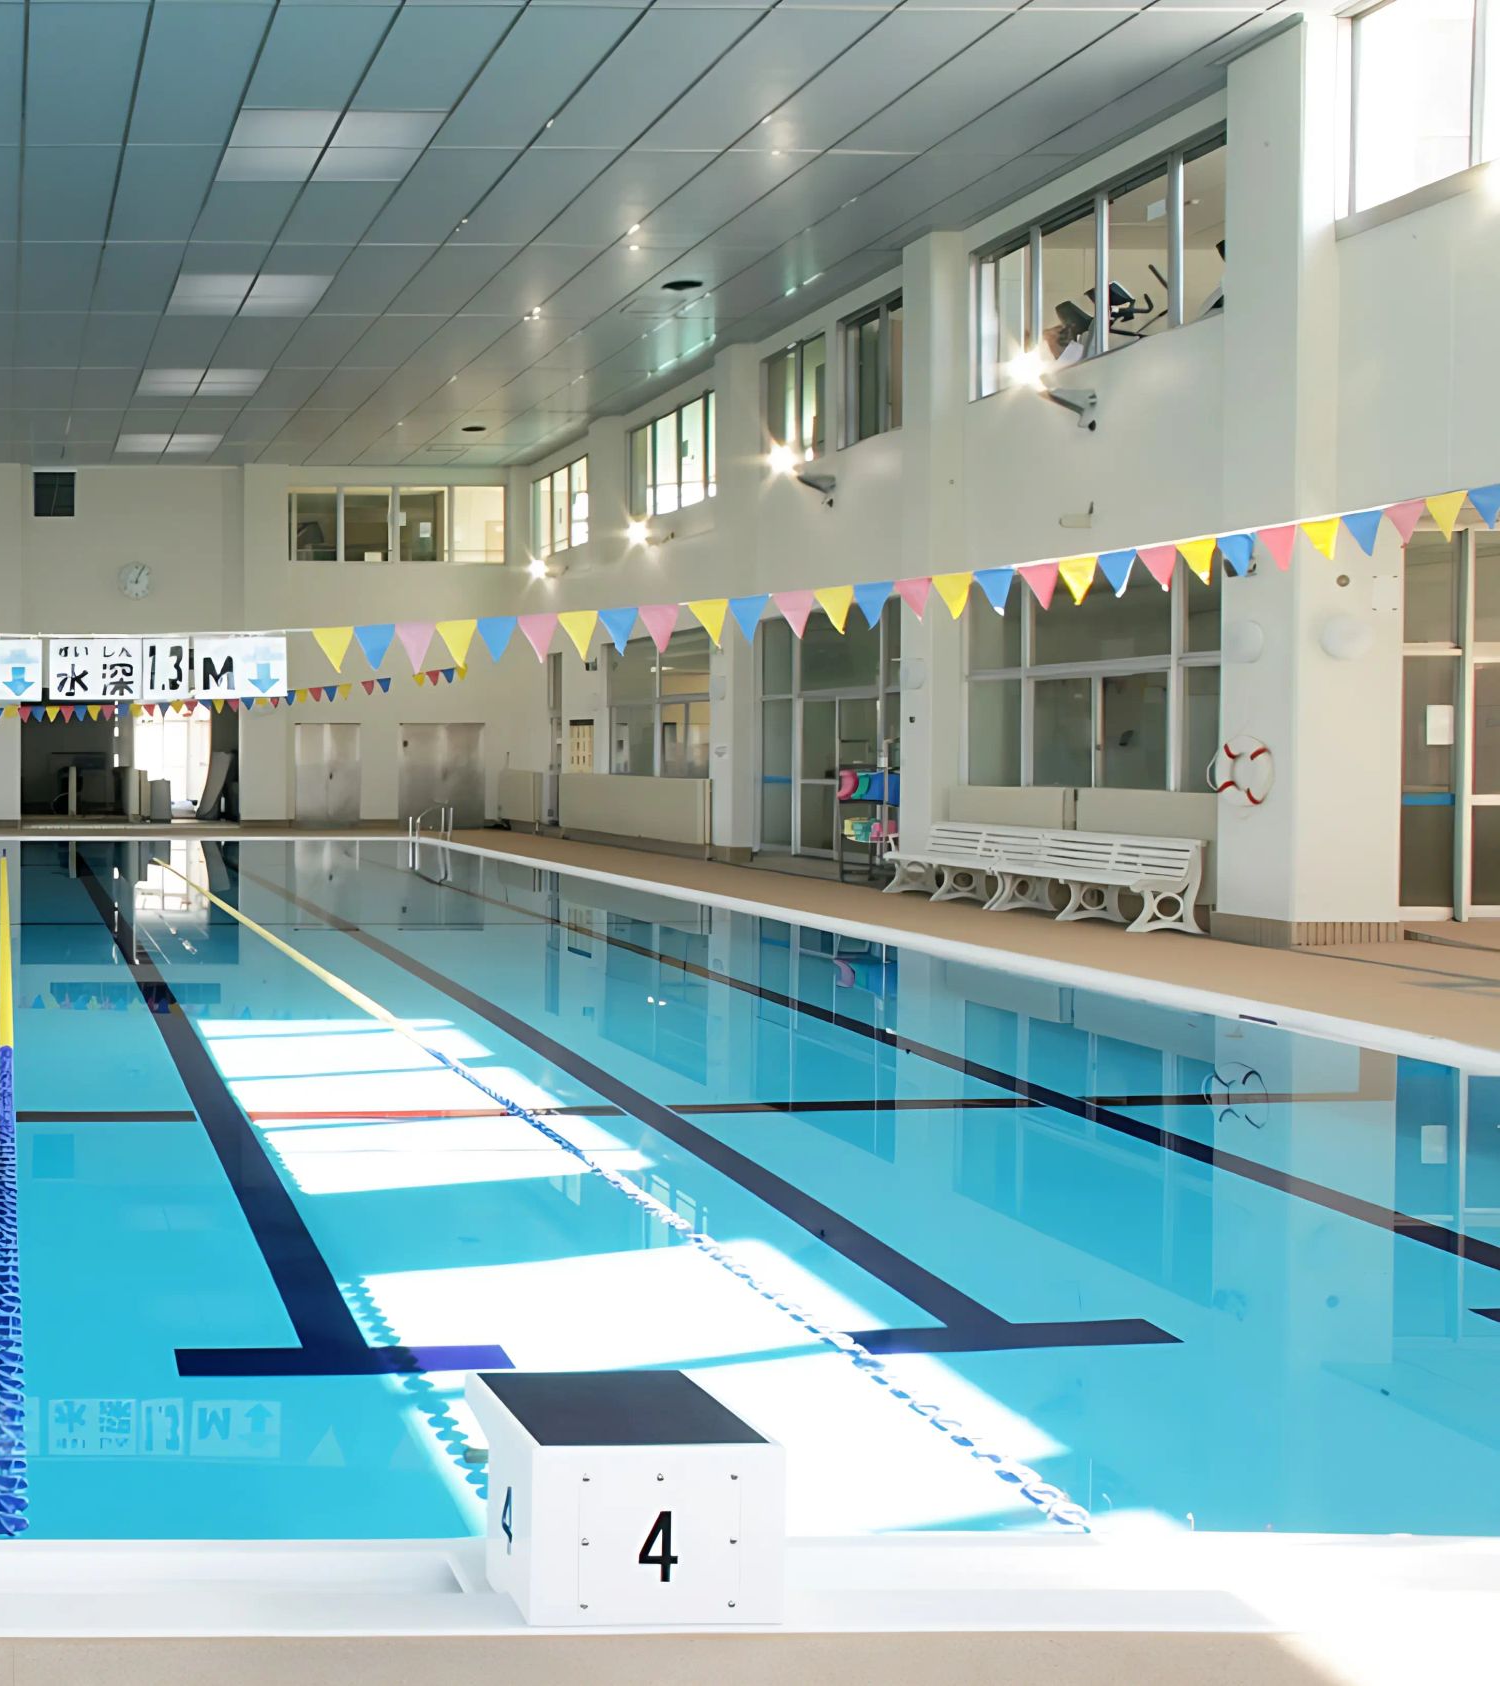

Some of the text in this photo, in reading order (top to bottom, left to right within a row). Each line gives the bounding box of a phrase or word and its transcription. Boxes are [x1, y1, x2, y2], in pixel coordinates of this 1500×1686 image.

[56, 663, 135, 697] 水深
[202, 655, 236, 691] M
[500, 1486, 513, 1555] 4
[638, 1510, 679, 1583] 4
